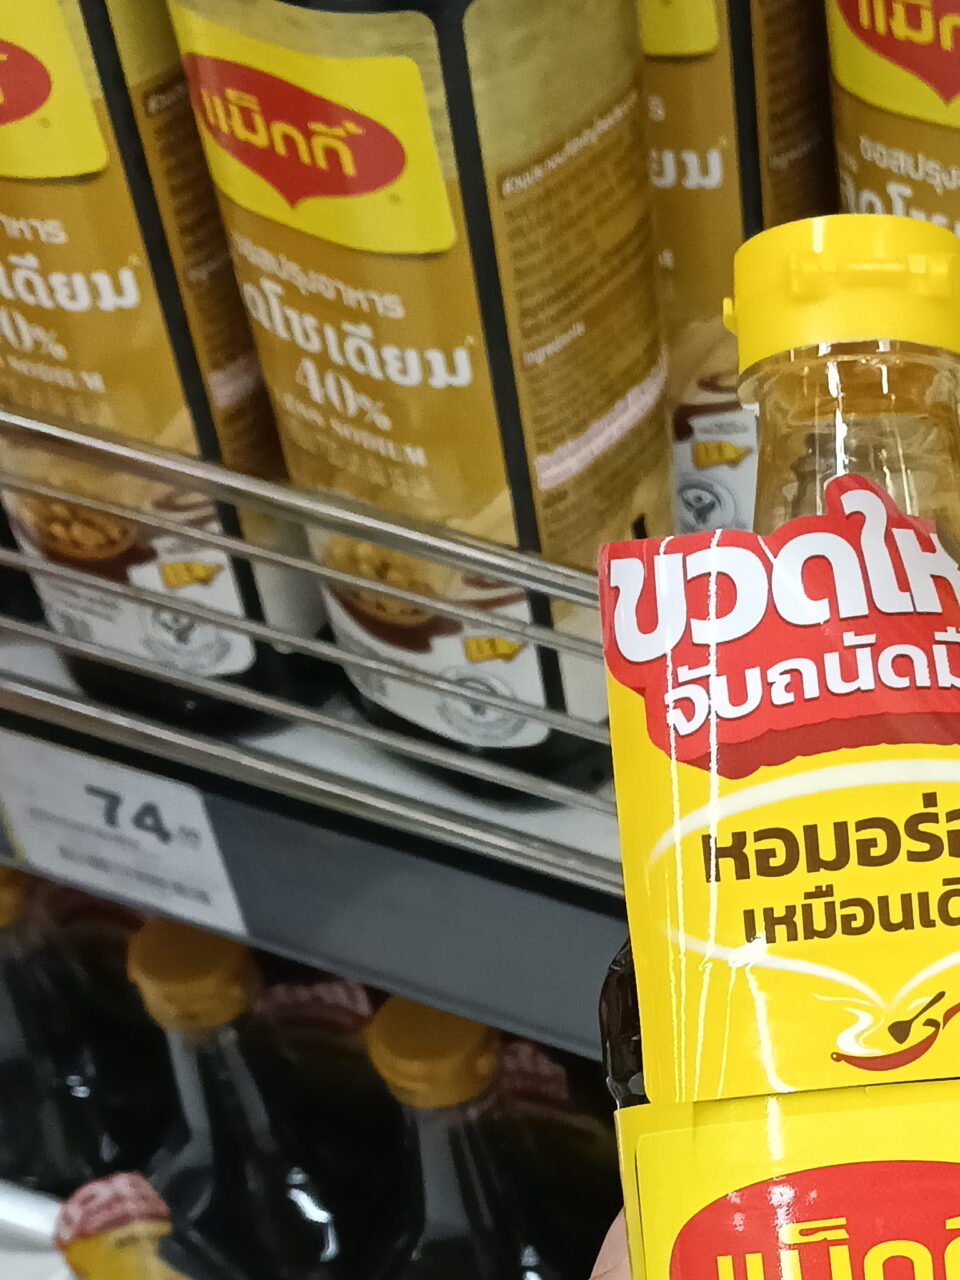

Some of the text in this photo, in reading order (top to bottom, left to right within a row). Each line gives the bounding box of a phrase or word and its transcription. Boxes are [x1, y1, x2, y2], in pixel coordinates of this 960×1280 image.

[200, 87, 365, 178] แม็กกี้
[84, 783, 173, 846] 74
